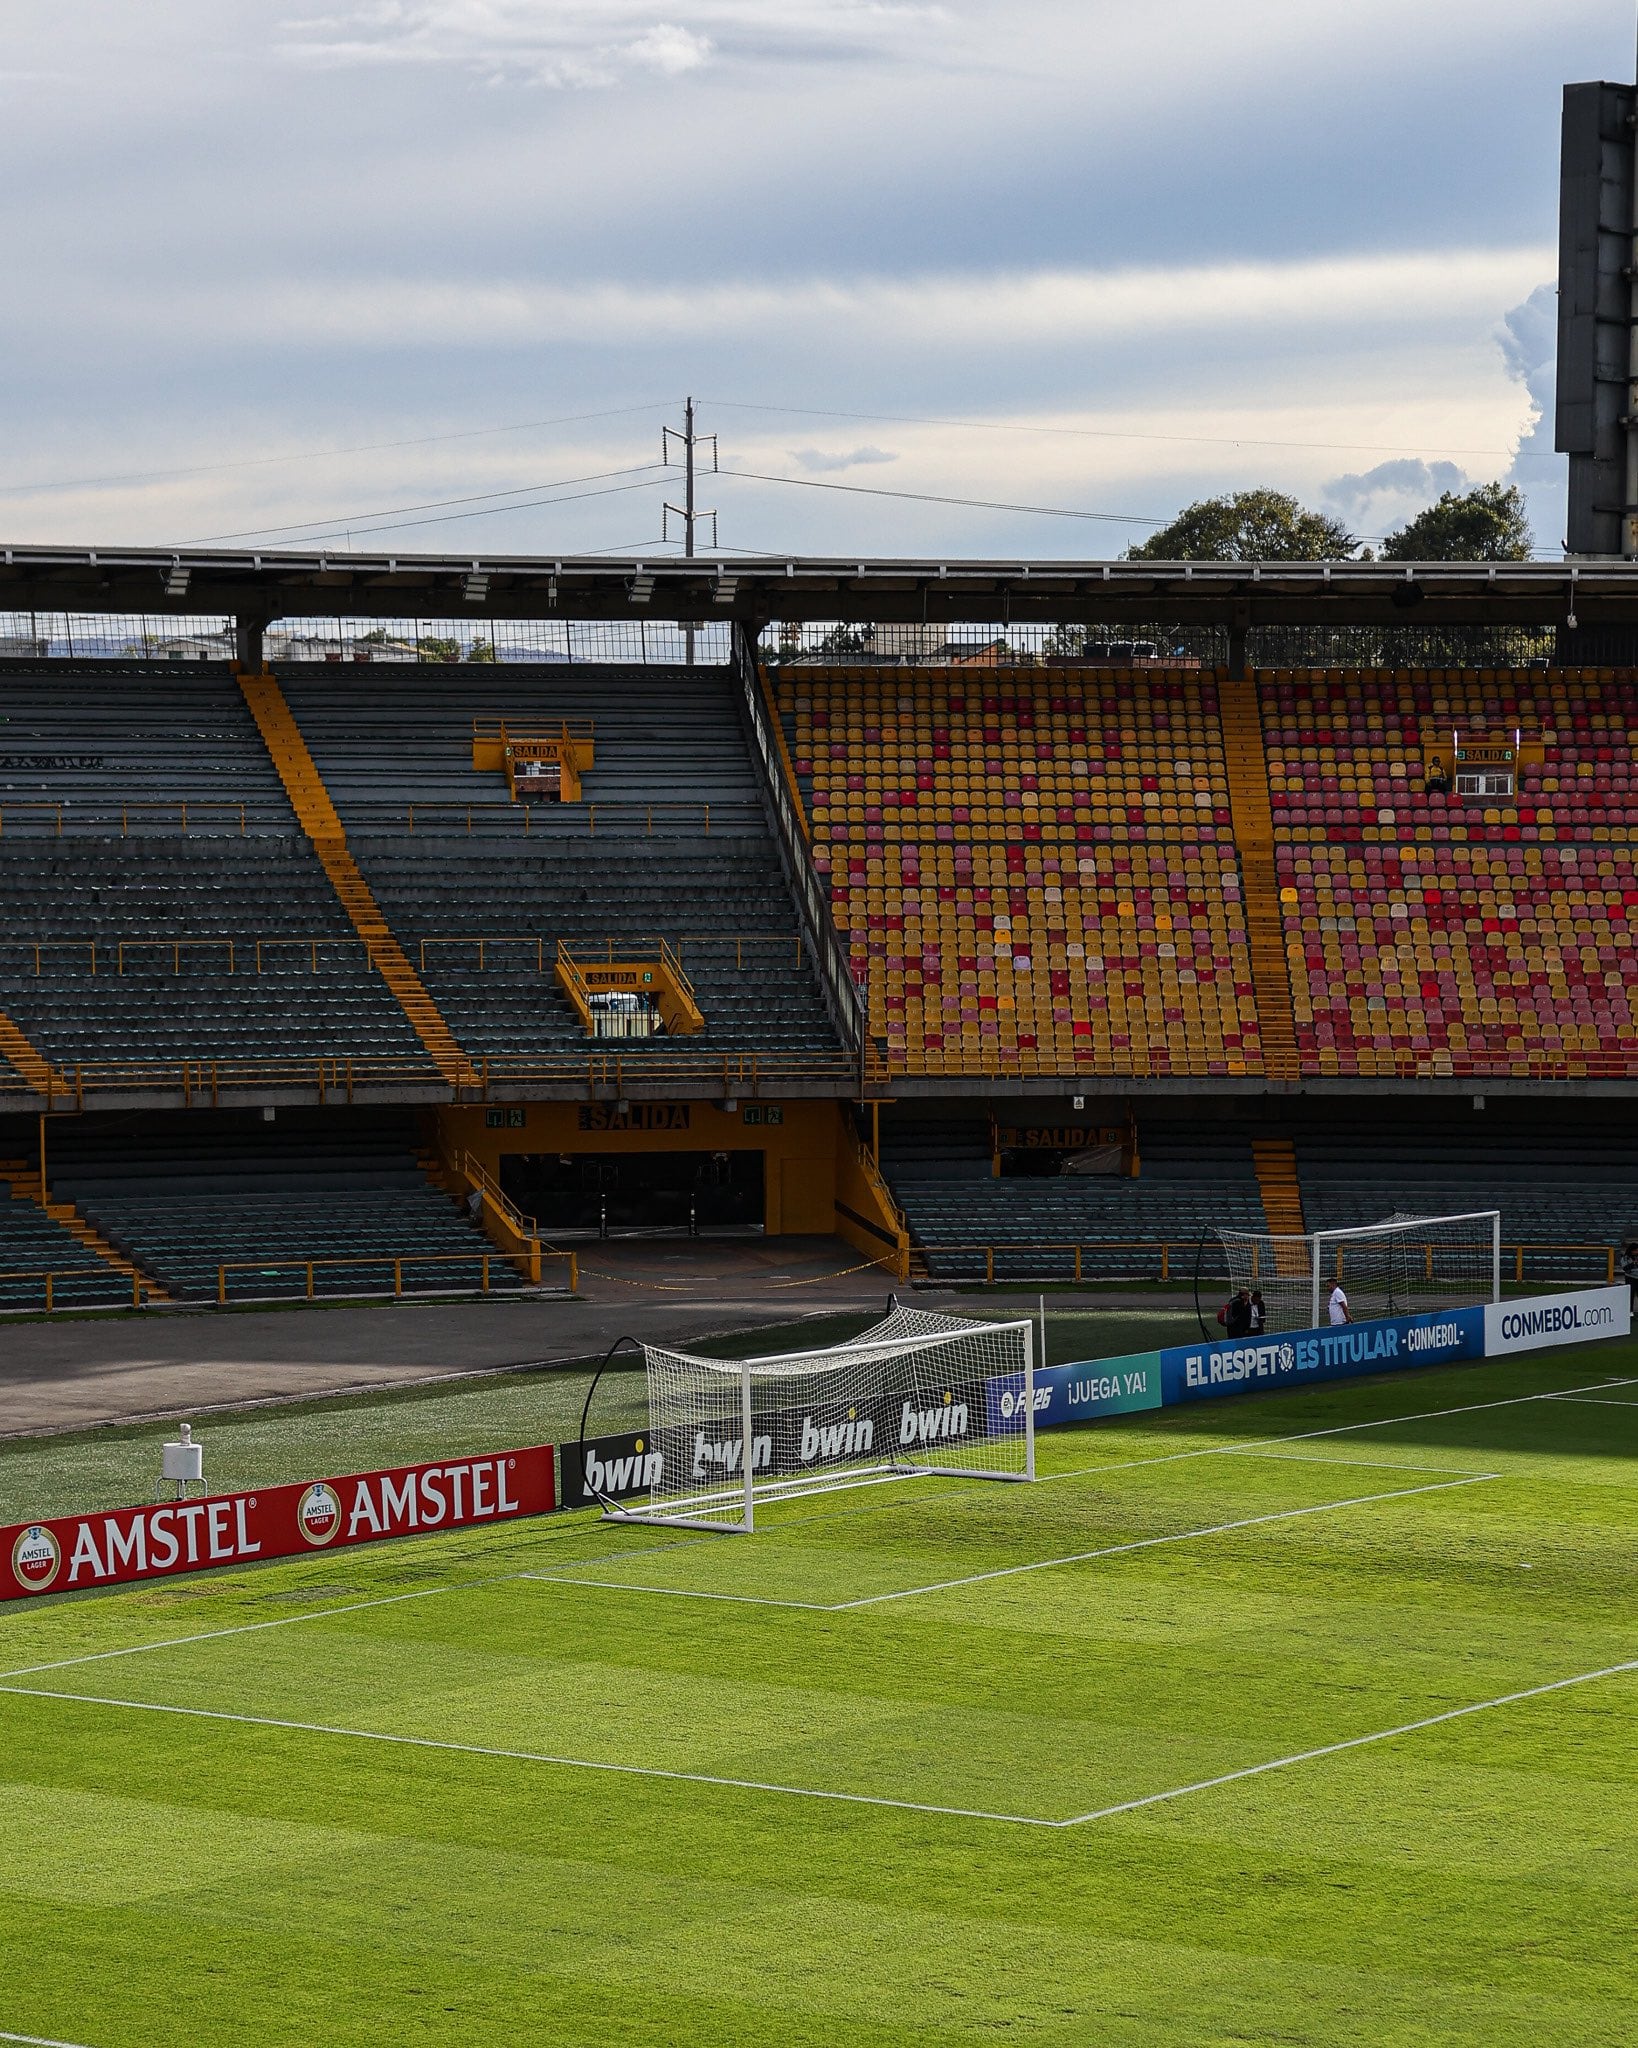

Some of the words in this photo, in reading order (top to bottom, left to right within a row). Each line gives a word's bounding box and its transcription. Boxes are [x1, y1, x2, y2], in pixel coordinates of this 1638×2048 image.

[514, 746, 556, 757] SALIDA
[592, 973, 636, 984] SALIDA
[591, 1105, 688, 1129] SALIDA
[1025, 1128, 1098, 1146] SALIDA
[1186, 1356, 1208, 1387] EL
[1297, 1339, 1319, 1370] ES
[1321, 1328, 1399, 1367] TITULAR
[1123, 1371, 1147, 1395] YA!
[900, 1391, 968, 1444] bwin
[801, 1407, 873, 1461] bwin
[583, 1439, 663, 1497] bwin
[306, 1503, 333, 1516] AMSTEL
[311, 1516, 329, 1525] LAGER
[22, 1547, 52, 1561] AMSTEL
[27, 1561, 47, 1570] LAGER
